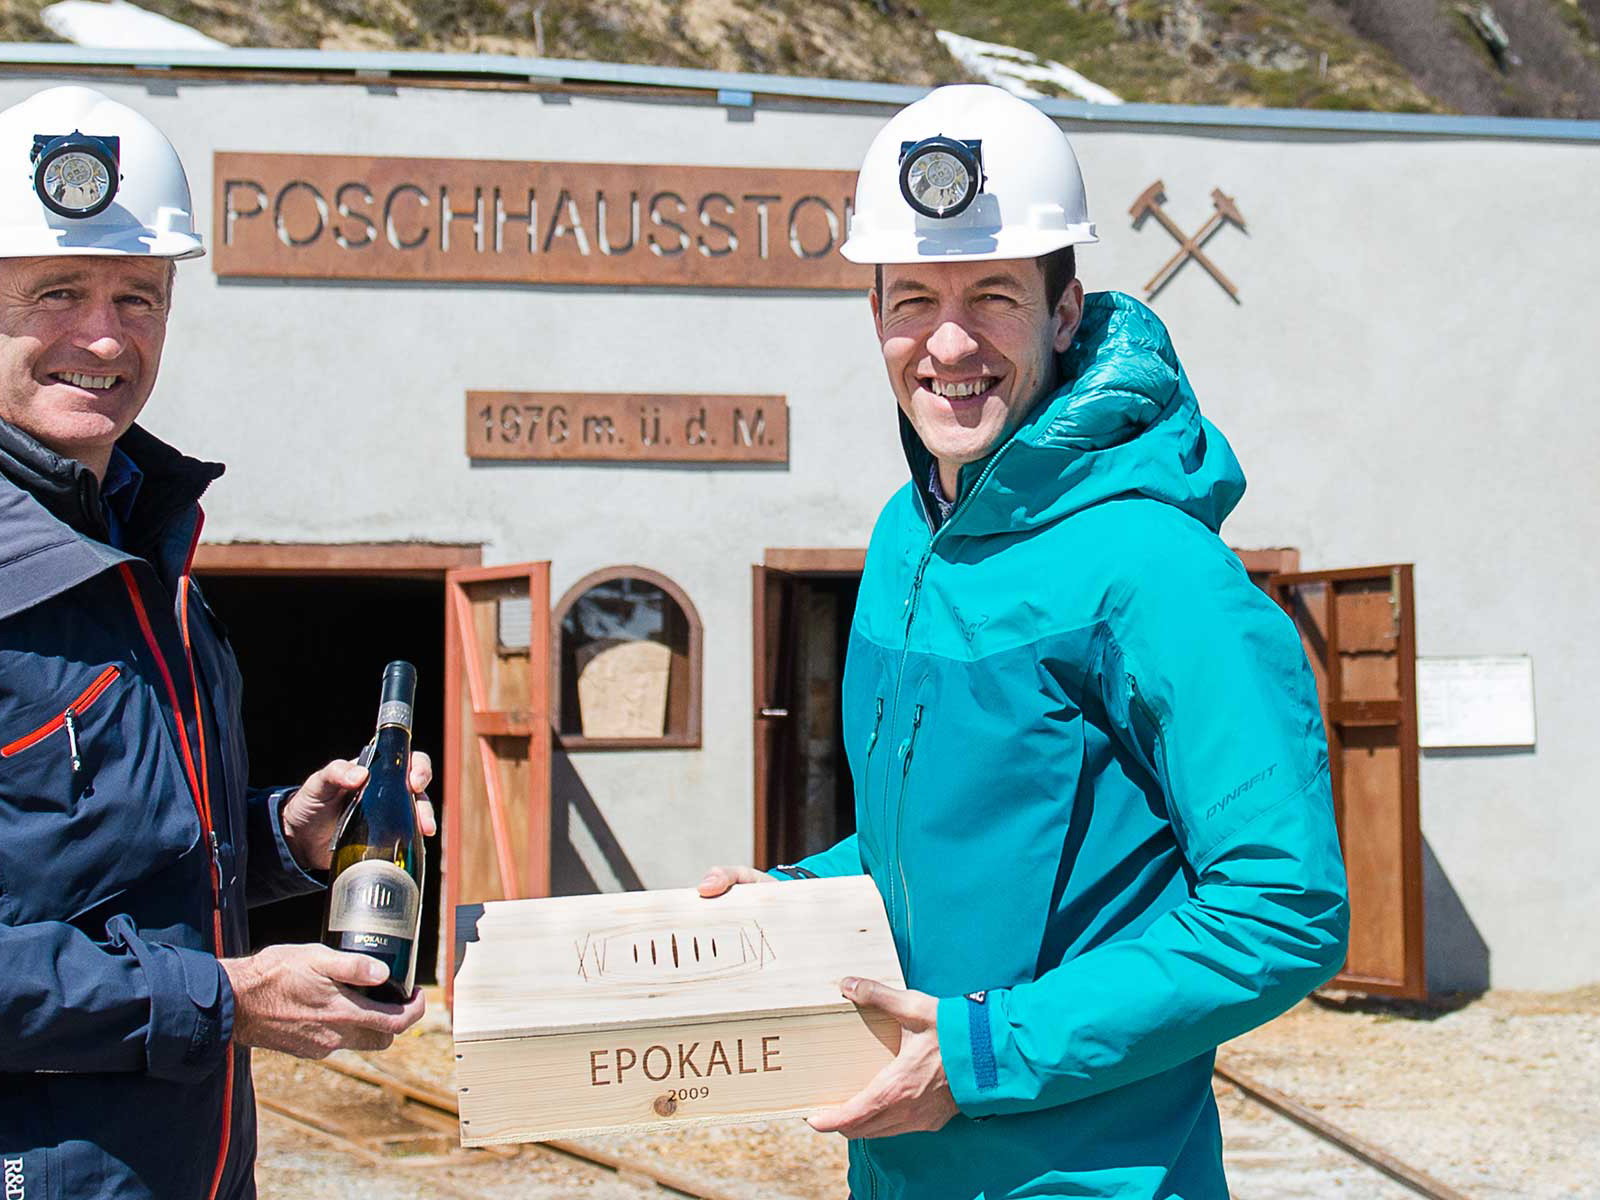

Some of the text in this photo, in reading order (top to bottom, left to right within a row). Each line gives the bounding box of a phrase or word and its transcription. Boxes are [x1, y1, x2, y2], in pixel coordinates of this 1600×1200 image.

[478, 404, 776, 447] 1976 m. ü. d. M.
[1205, 762, 1278, 821] DYNAFIT
[354, 934, 388, 946] EPOKALE
[589, 1036, 783, 1086] EPOKALE
[667, 1086, 710, 1102] 2009
